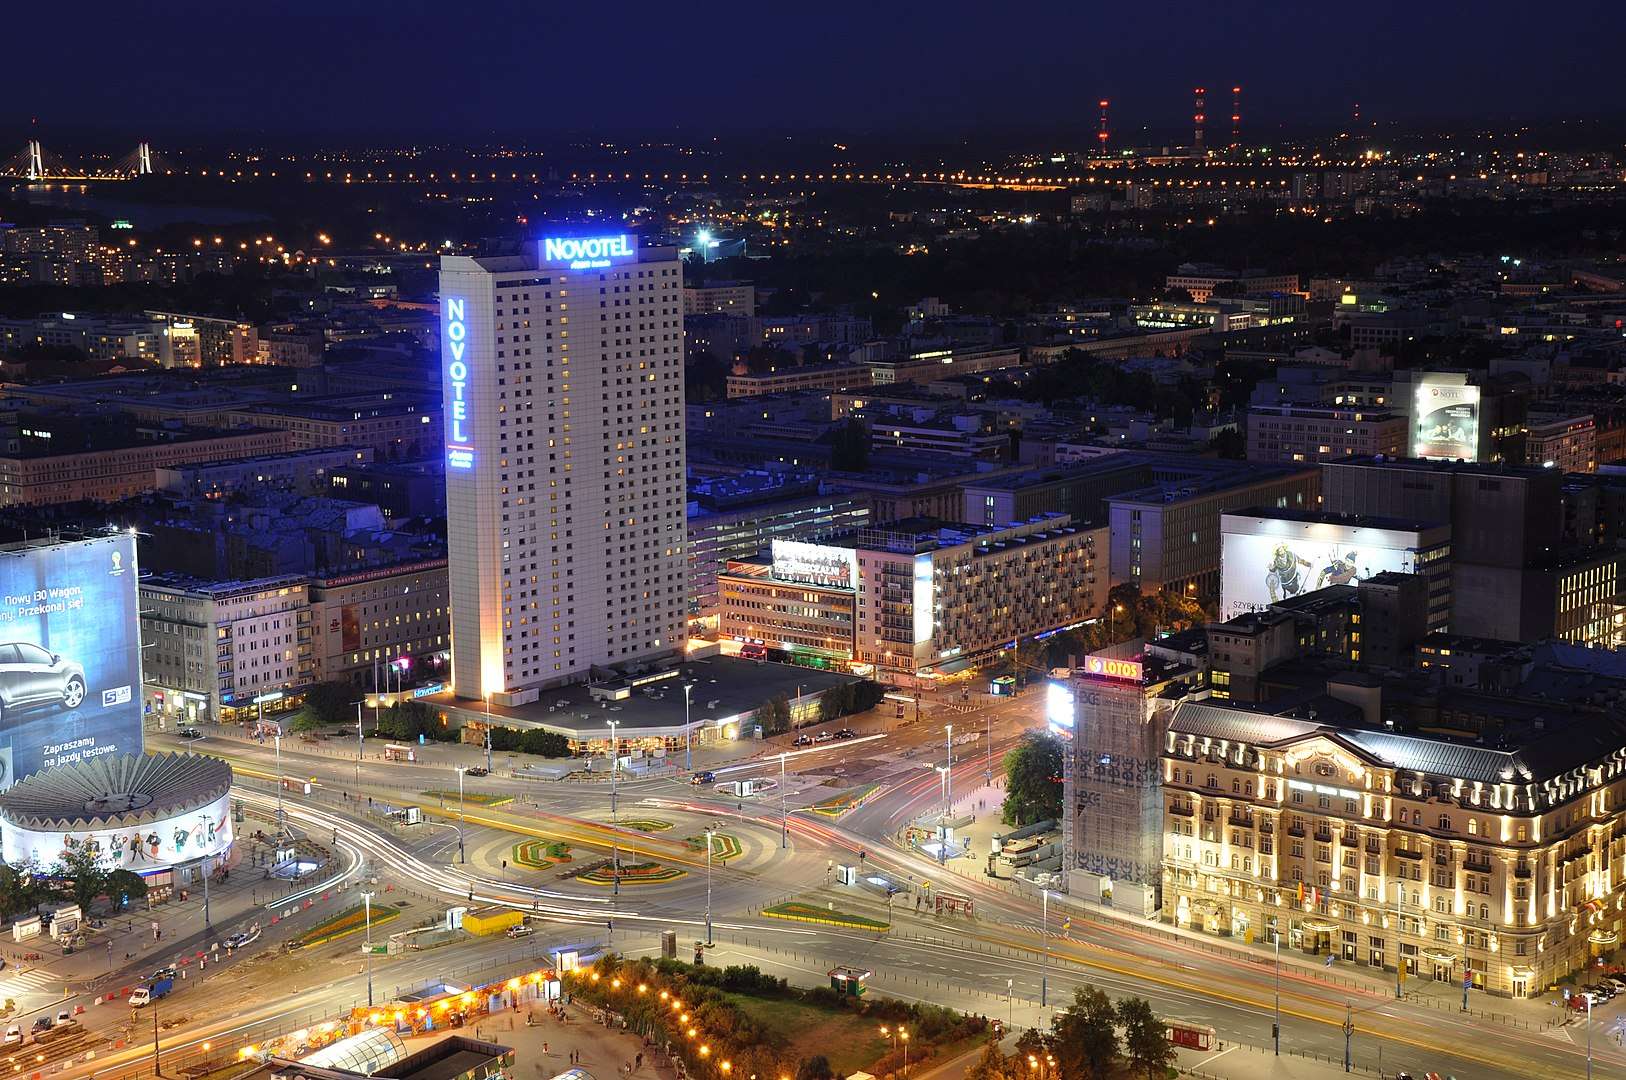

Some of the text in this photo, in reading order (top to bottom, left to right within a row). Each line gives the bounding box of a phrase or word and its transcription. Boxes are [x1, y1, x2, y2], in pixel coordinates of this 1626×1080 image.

[546, 235, 633, 260] NOVOTEL
[448, 299, 467, 442] NOVOTEL
[4, 594, 31, 606] Nowy
[33, 590, 47, 602] i30
[18, 599, 66, 617] Przekonaj
[1103, 660, 1138, 678] LOTOS
[43, 736, 95, 755] Zapraszamy
[44, 744, 118, 767] na jazdy testowe.
